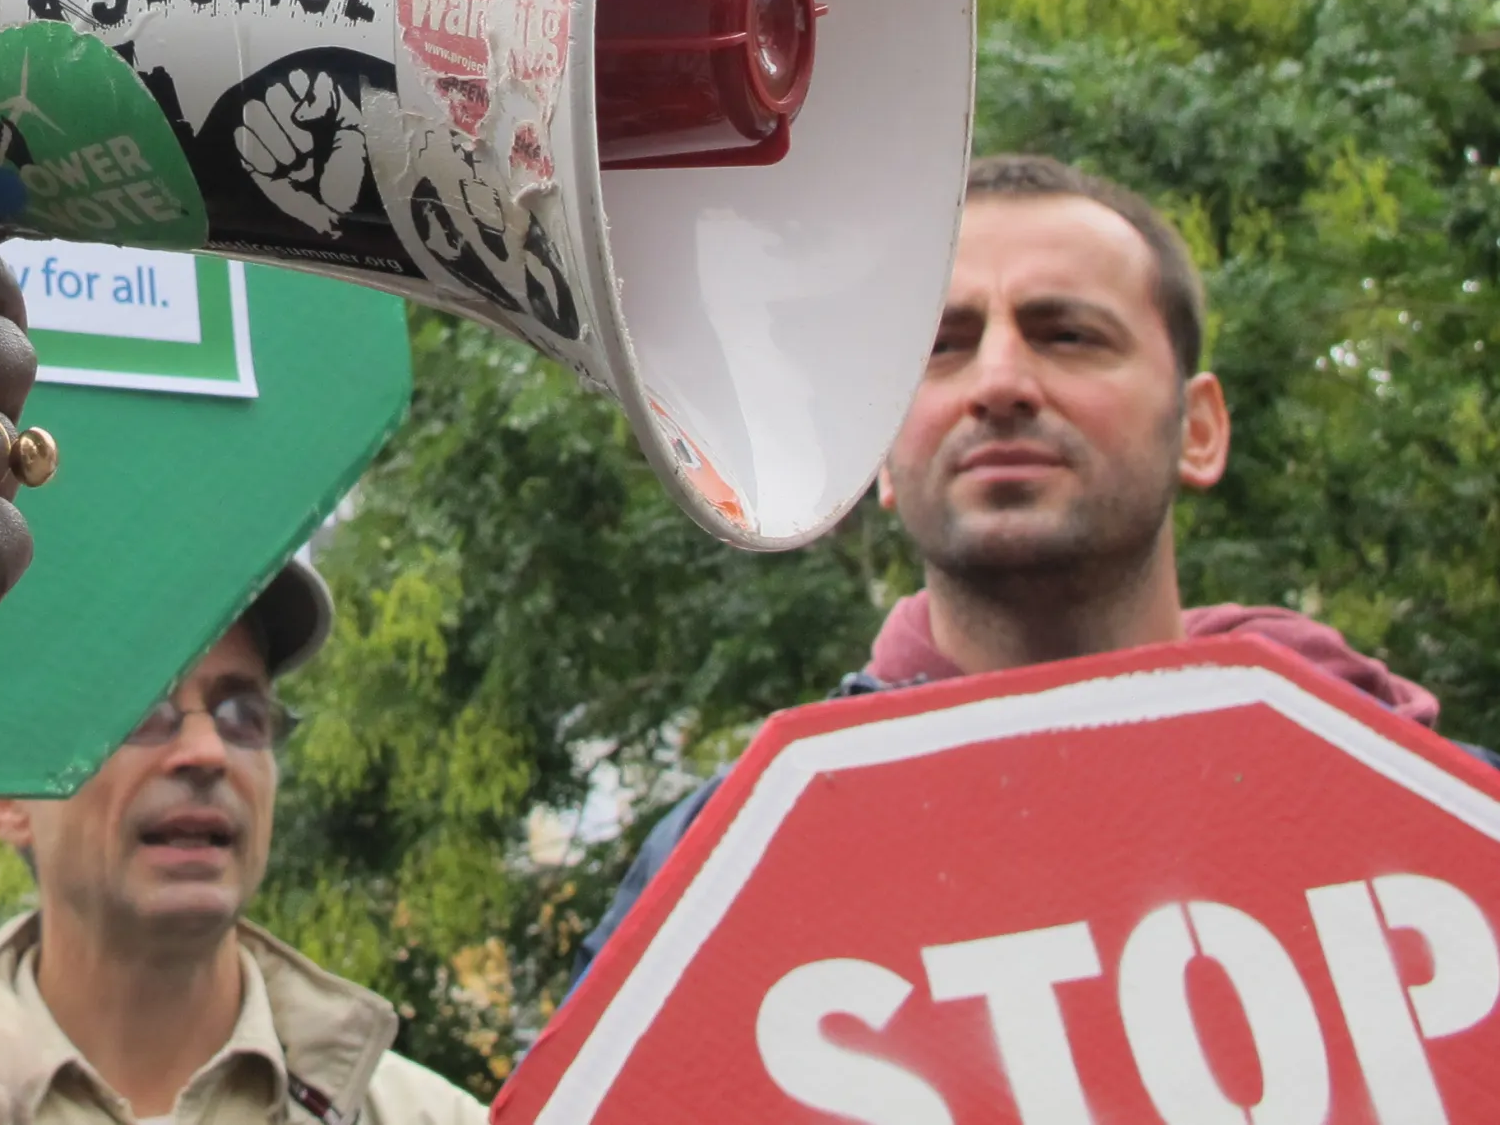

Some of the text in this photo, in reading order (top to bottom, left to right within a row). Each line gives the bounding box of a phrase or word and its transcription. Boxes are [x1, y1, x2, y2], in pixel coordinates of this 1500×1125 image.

[19, 135, 153, 198] OWER
[41, 257, 100, 300] for
[112, 266, 169, 307] all.
[756, 873, 1500, 1125] STOP
